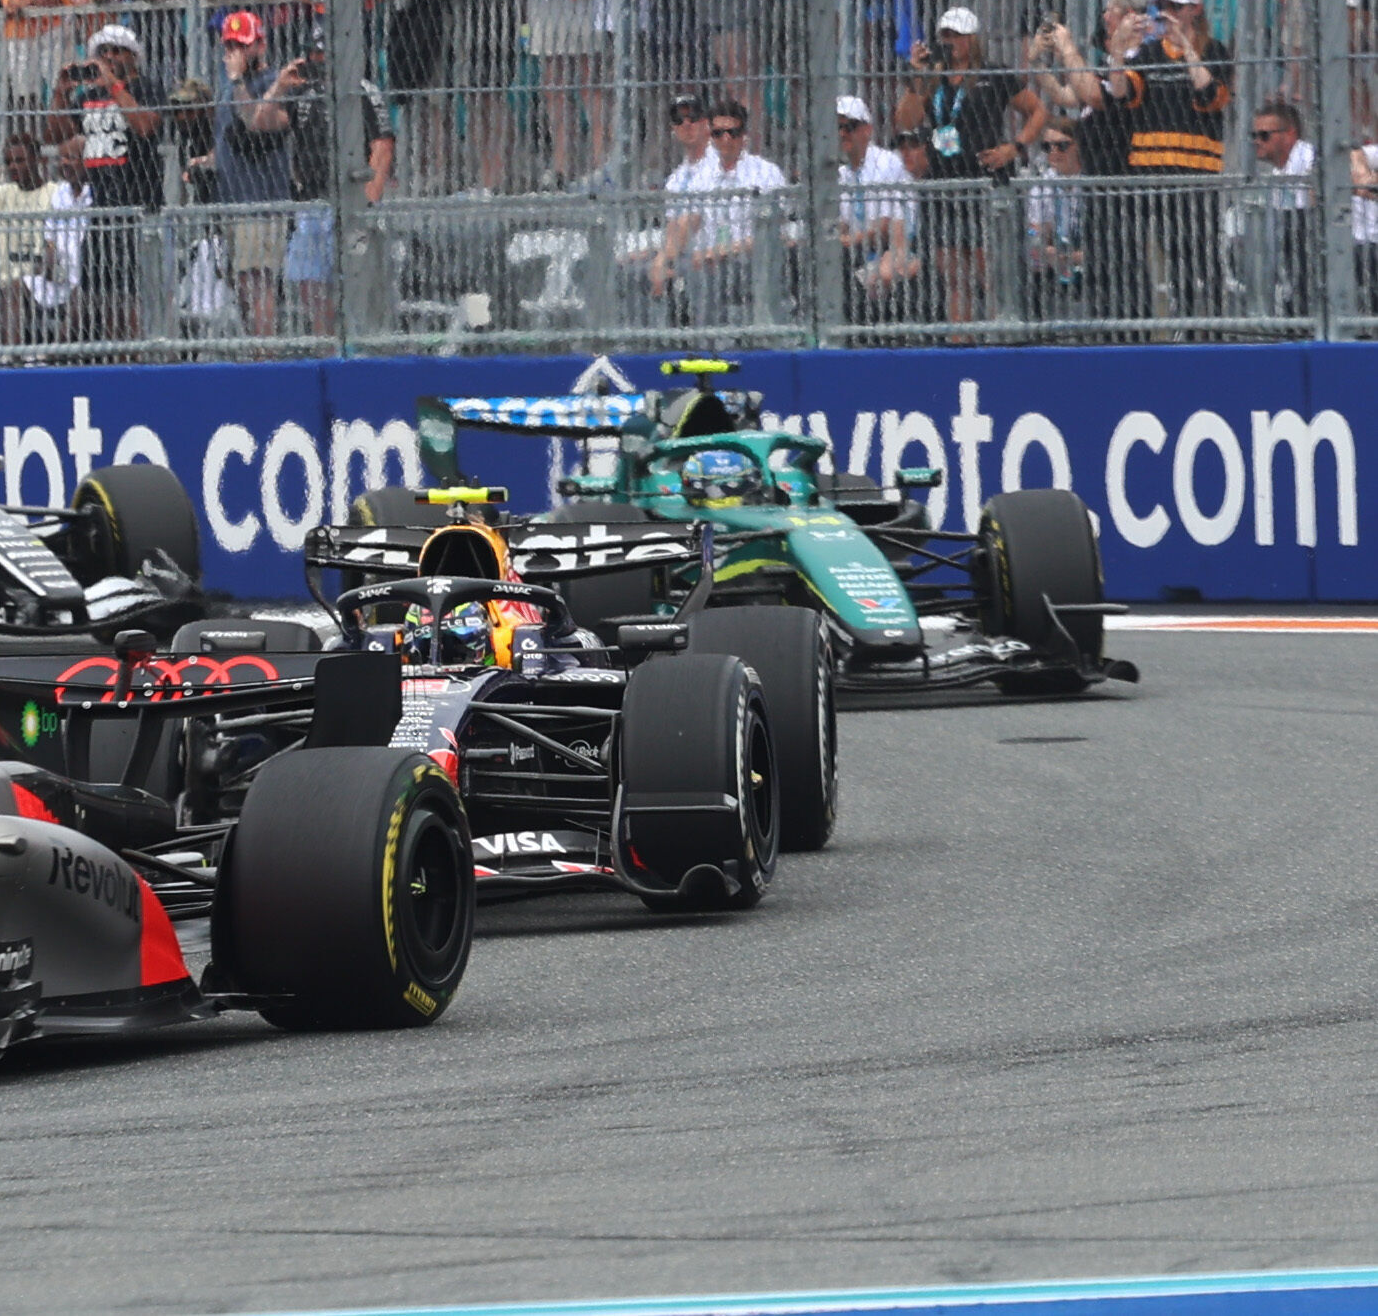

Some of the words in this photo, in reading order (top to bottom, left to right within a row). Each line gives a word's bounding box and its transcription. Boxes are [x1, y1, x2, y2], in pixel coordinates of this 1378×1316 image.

[41, 707, 58, 739] bp
[471, 831, 567, 854] VISA
[48, 844, 140, 923] Revolut
